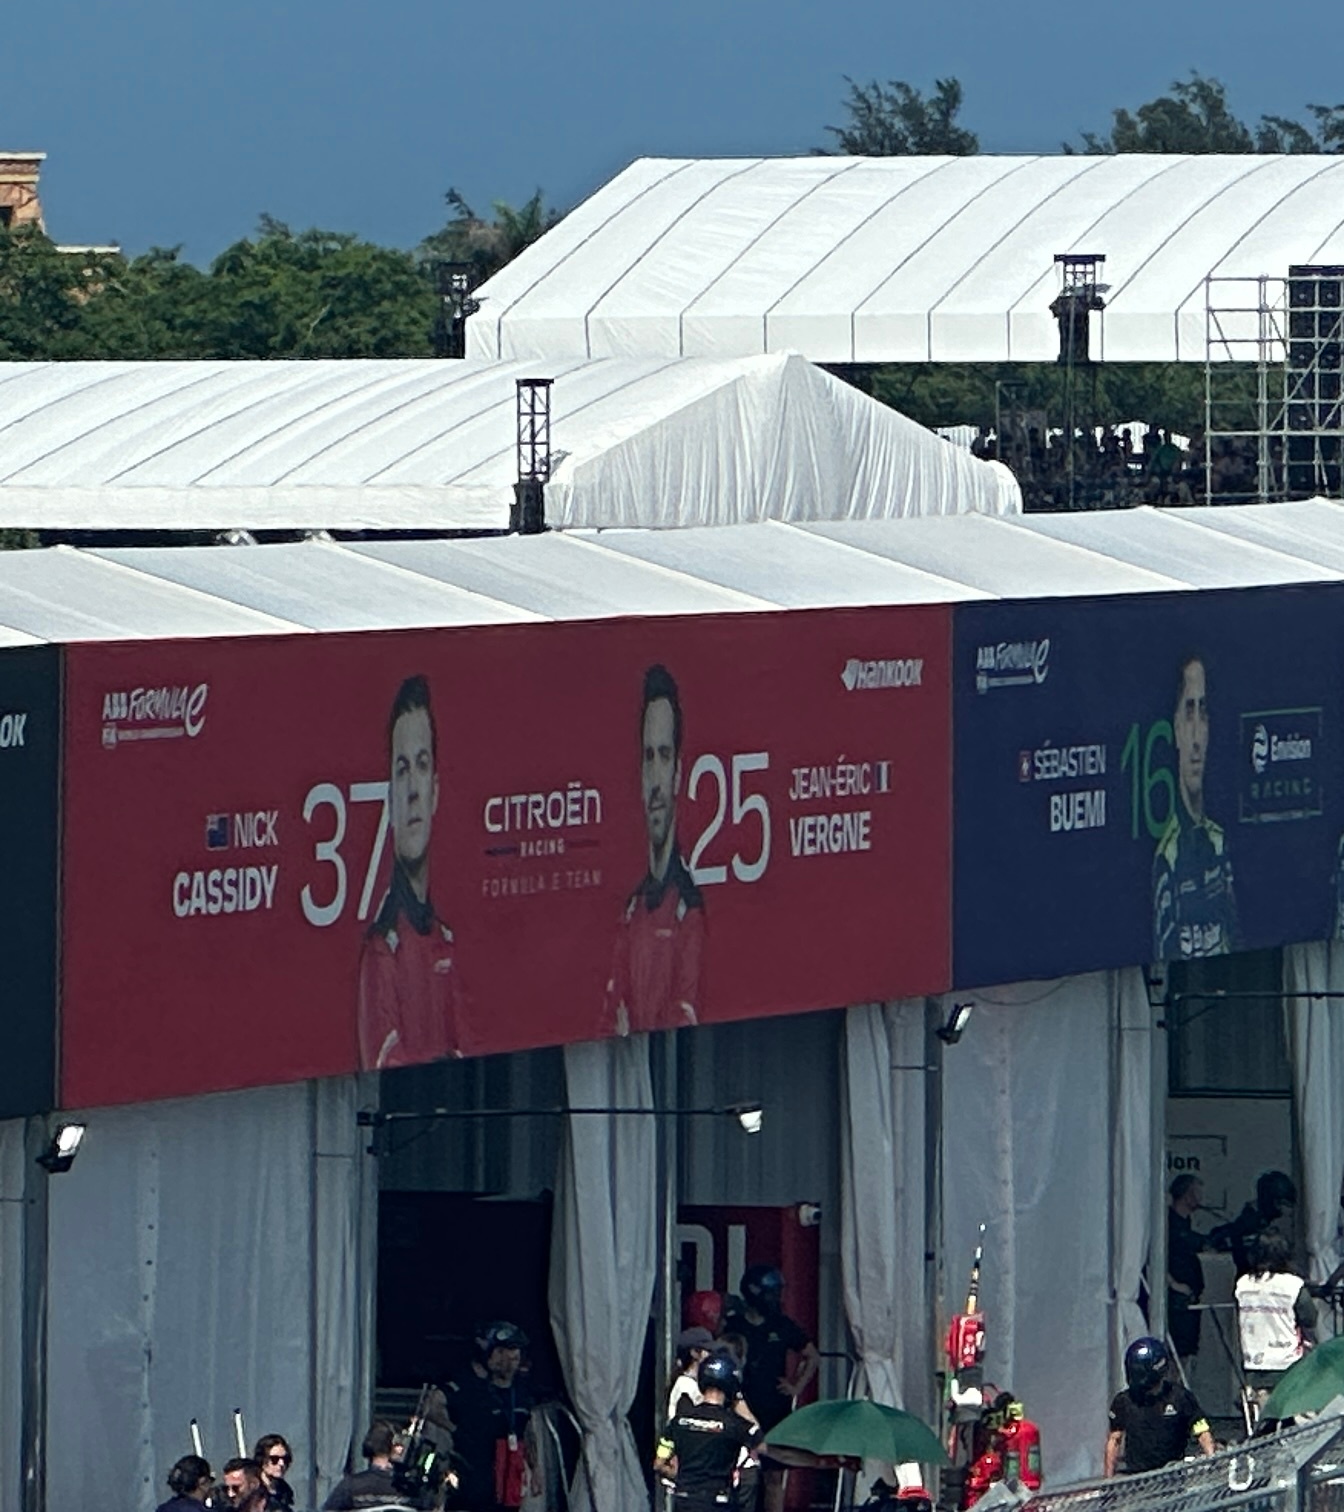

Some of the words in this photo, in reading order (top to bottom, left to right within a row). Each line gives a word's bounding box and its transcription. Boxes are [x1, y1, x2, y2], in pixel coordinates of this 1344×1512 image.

[789, 754, 871, 801] JEAN-ÉRIC
[1034, 739, 1106, 780] SÉBASTIEN
[1119, 719, 1176, 840] 16
[1251, 776, 1313, 799] RACING
[233, 811, 279, 847] NICK
[681, 751, 771, 886] 25
[1050, 789, 1106, 832] BUEMI
[301, 781, 391, 927] 37
[520, 838, 565, 858] RACING
[789, 810, 872, 857] VERGNE
[172, 865, 279, 917] CASSIDY
[482, 873, 547, 898] FORMULA
[552, 872, 561, 891] E
[566, 869, 602, 888] TEAM
